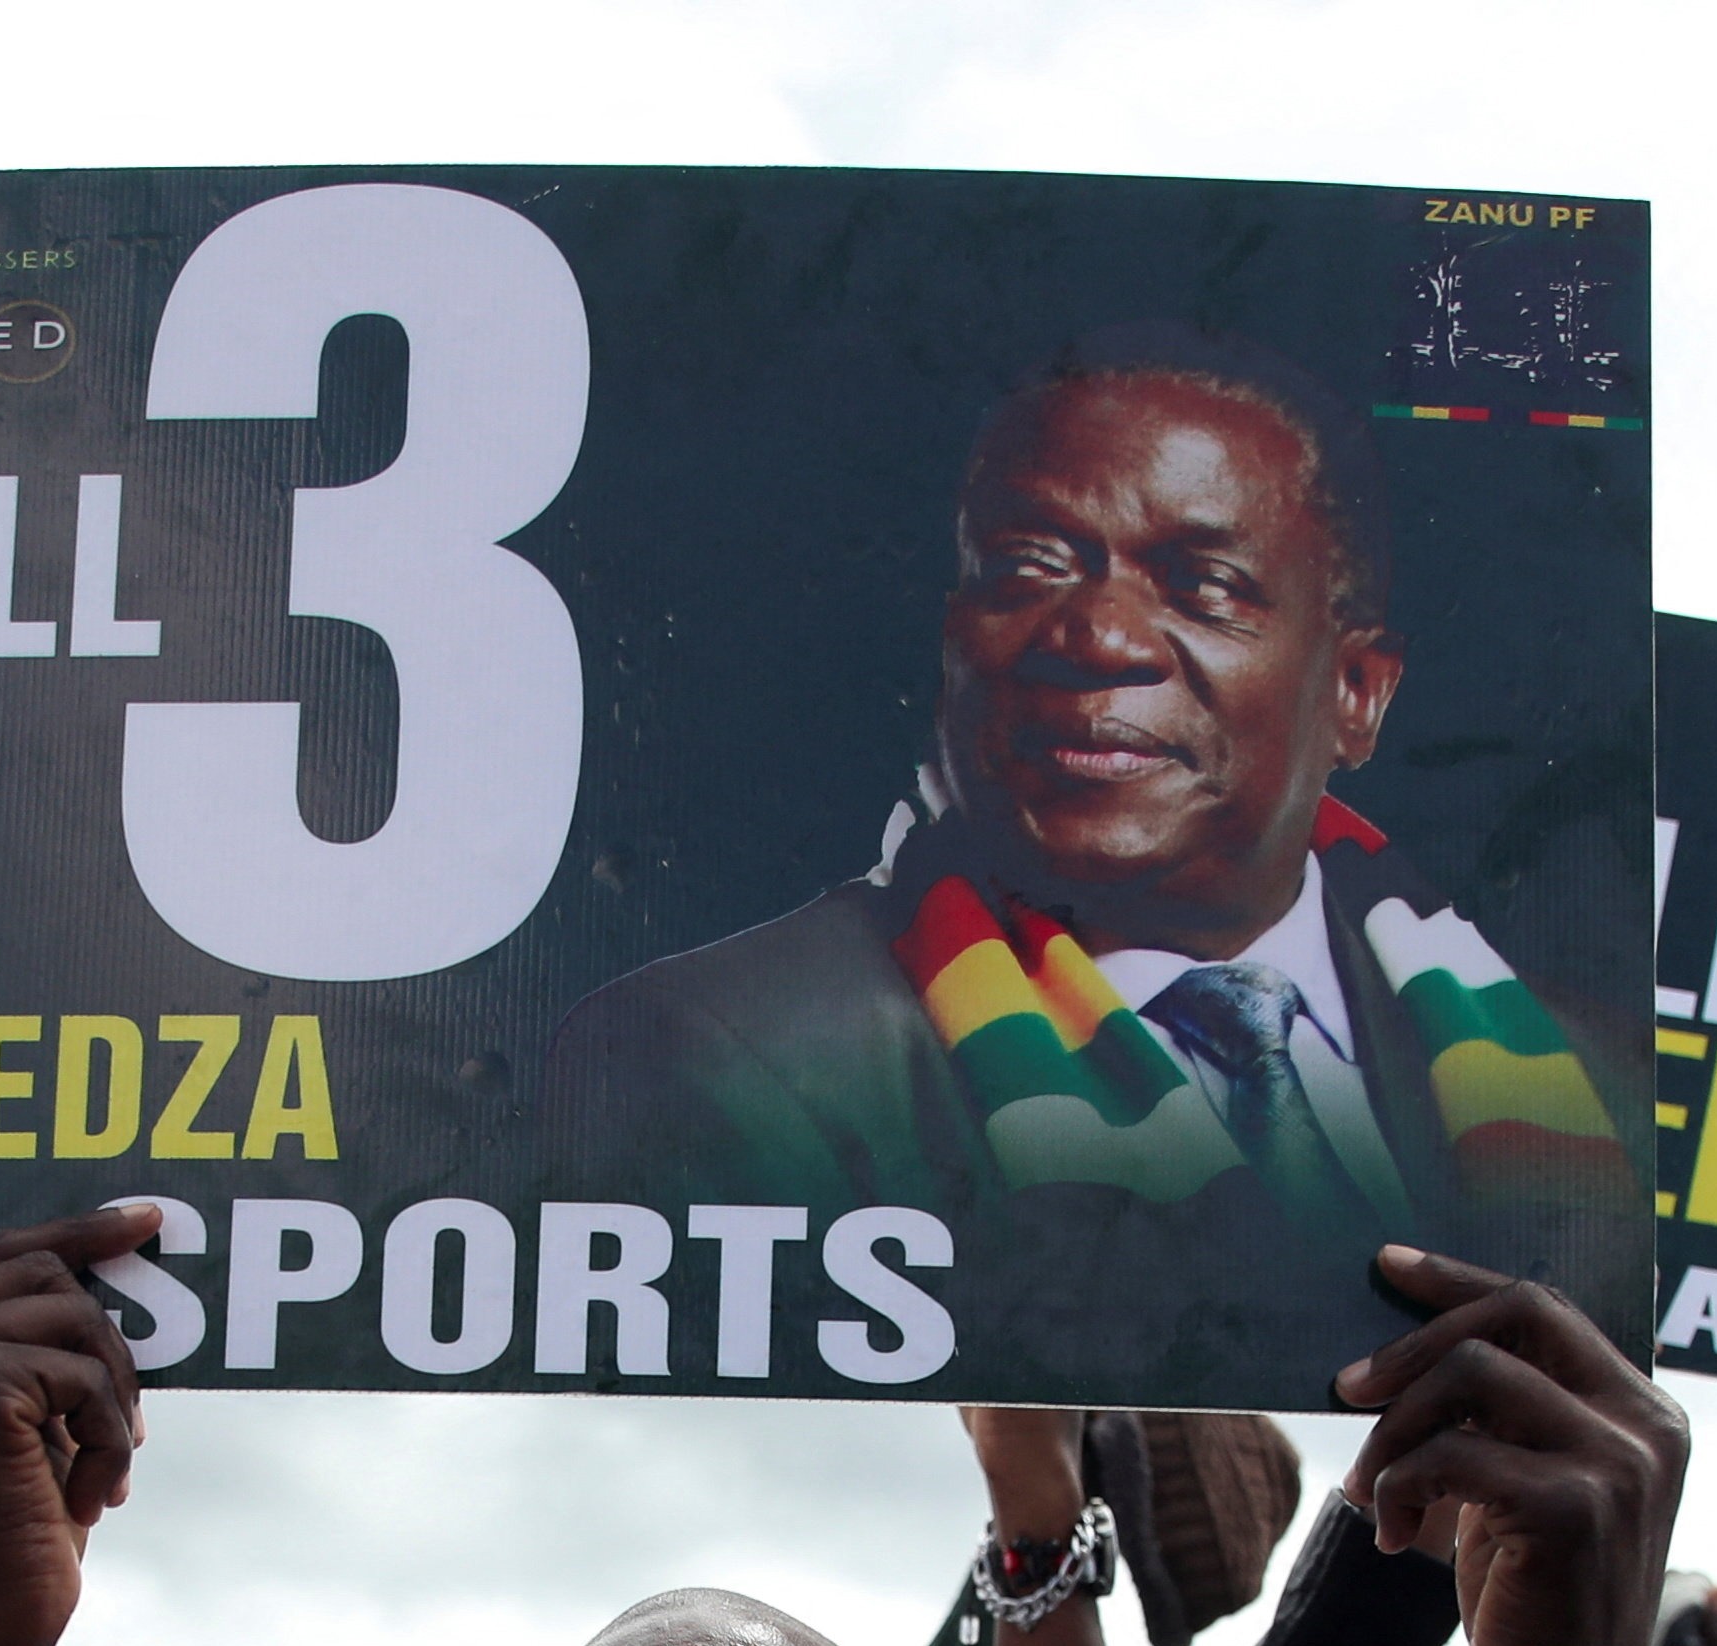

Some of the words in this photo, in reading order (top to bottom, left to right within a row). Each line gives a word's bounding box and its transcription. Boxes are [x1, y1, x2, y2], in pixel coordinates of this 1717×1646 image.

[1424, 200, 1534, 227] ZANU
[1549, 206, 1596, 229] PF
[120, 182, 592, 983] 3
[86, 1197, 956, 1385] SPORTS
